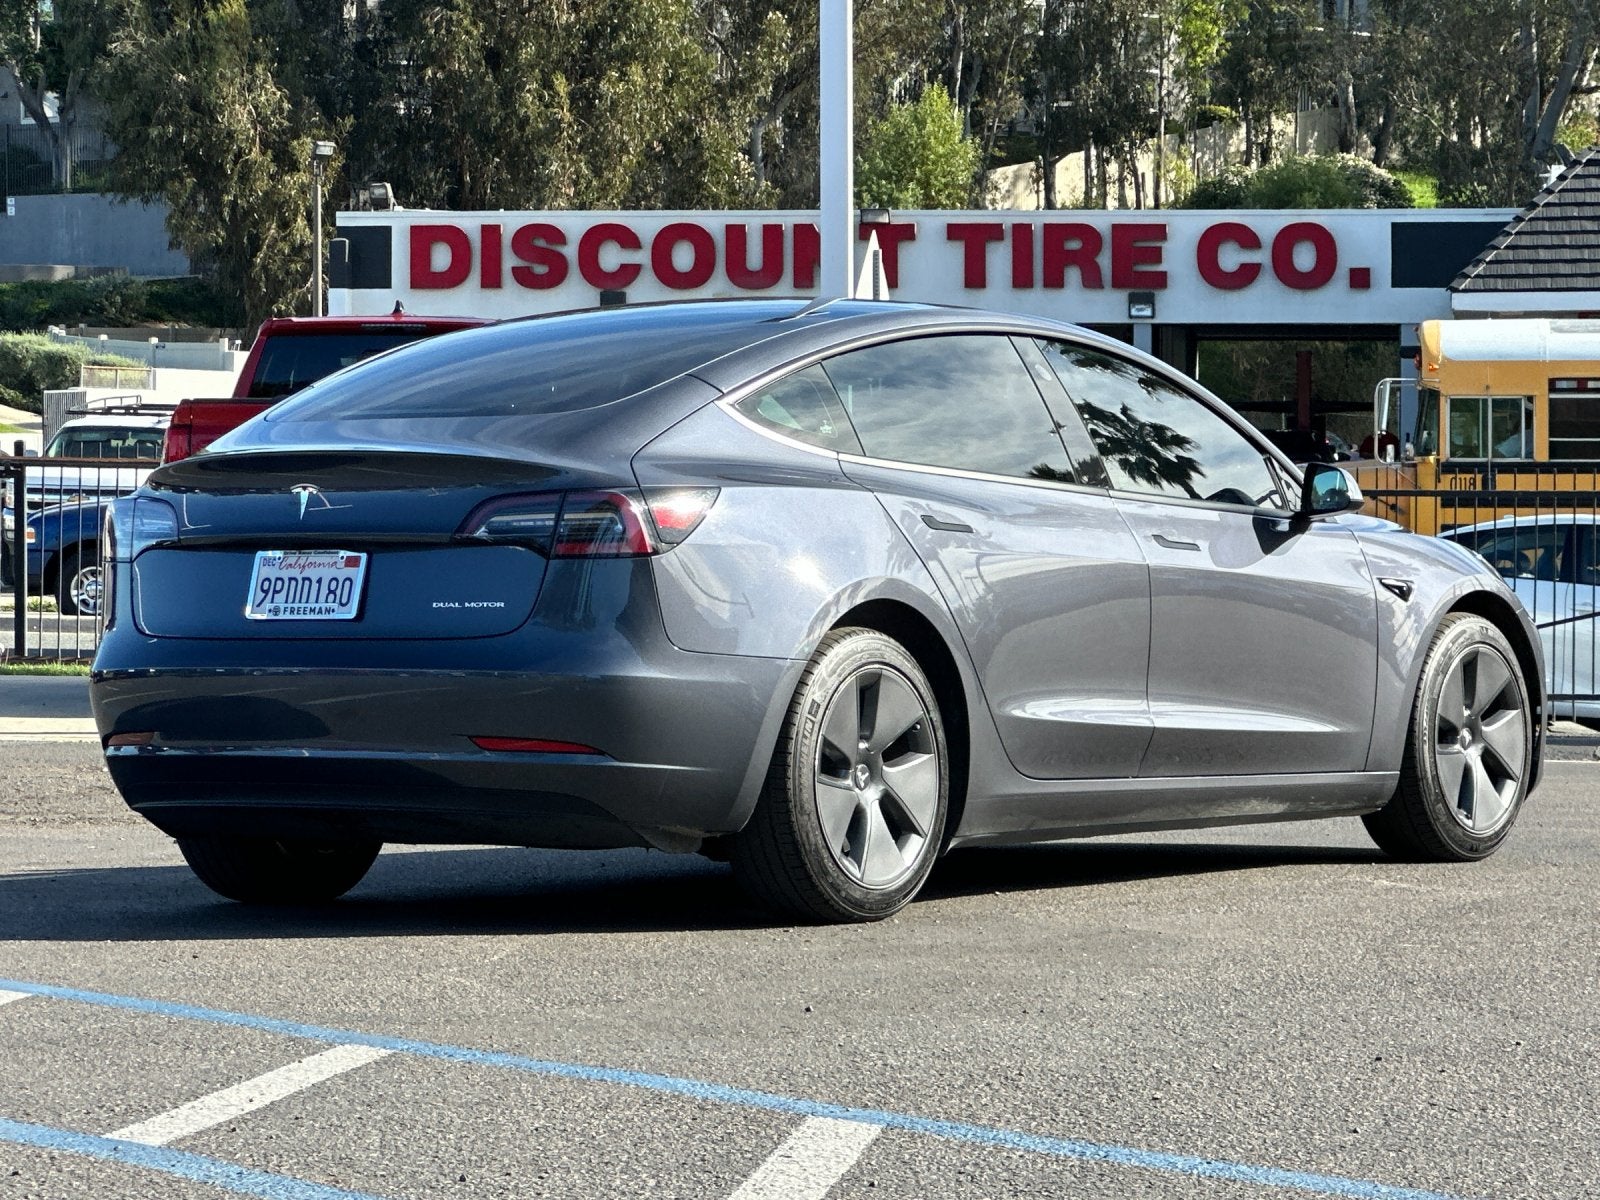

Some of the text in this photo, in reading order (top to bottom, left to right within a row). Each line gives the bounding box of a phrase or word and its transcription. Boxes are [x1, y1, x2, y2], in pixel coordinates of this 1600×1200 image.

[947, 223, 1168, 289] TIRE
[1197, 222, 1371, 290] CO.
[262, 558, 276, 567] DEC
[278, 556, 339, 574] California
[283, 606, 332, 616] FREEMAN
